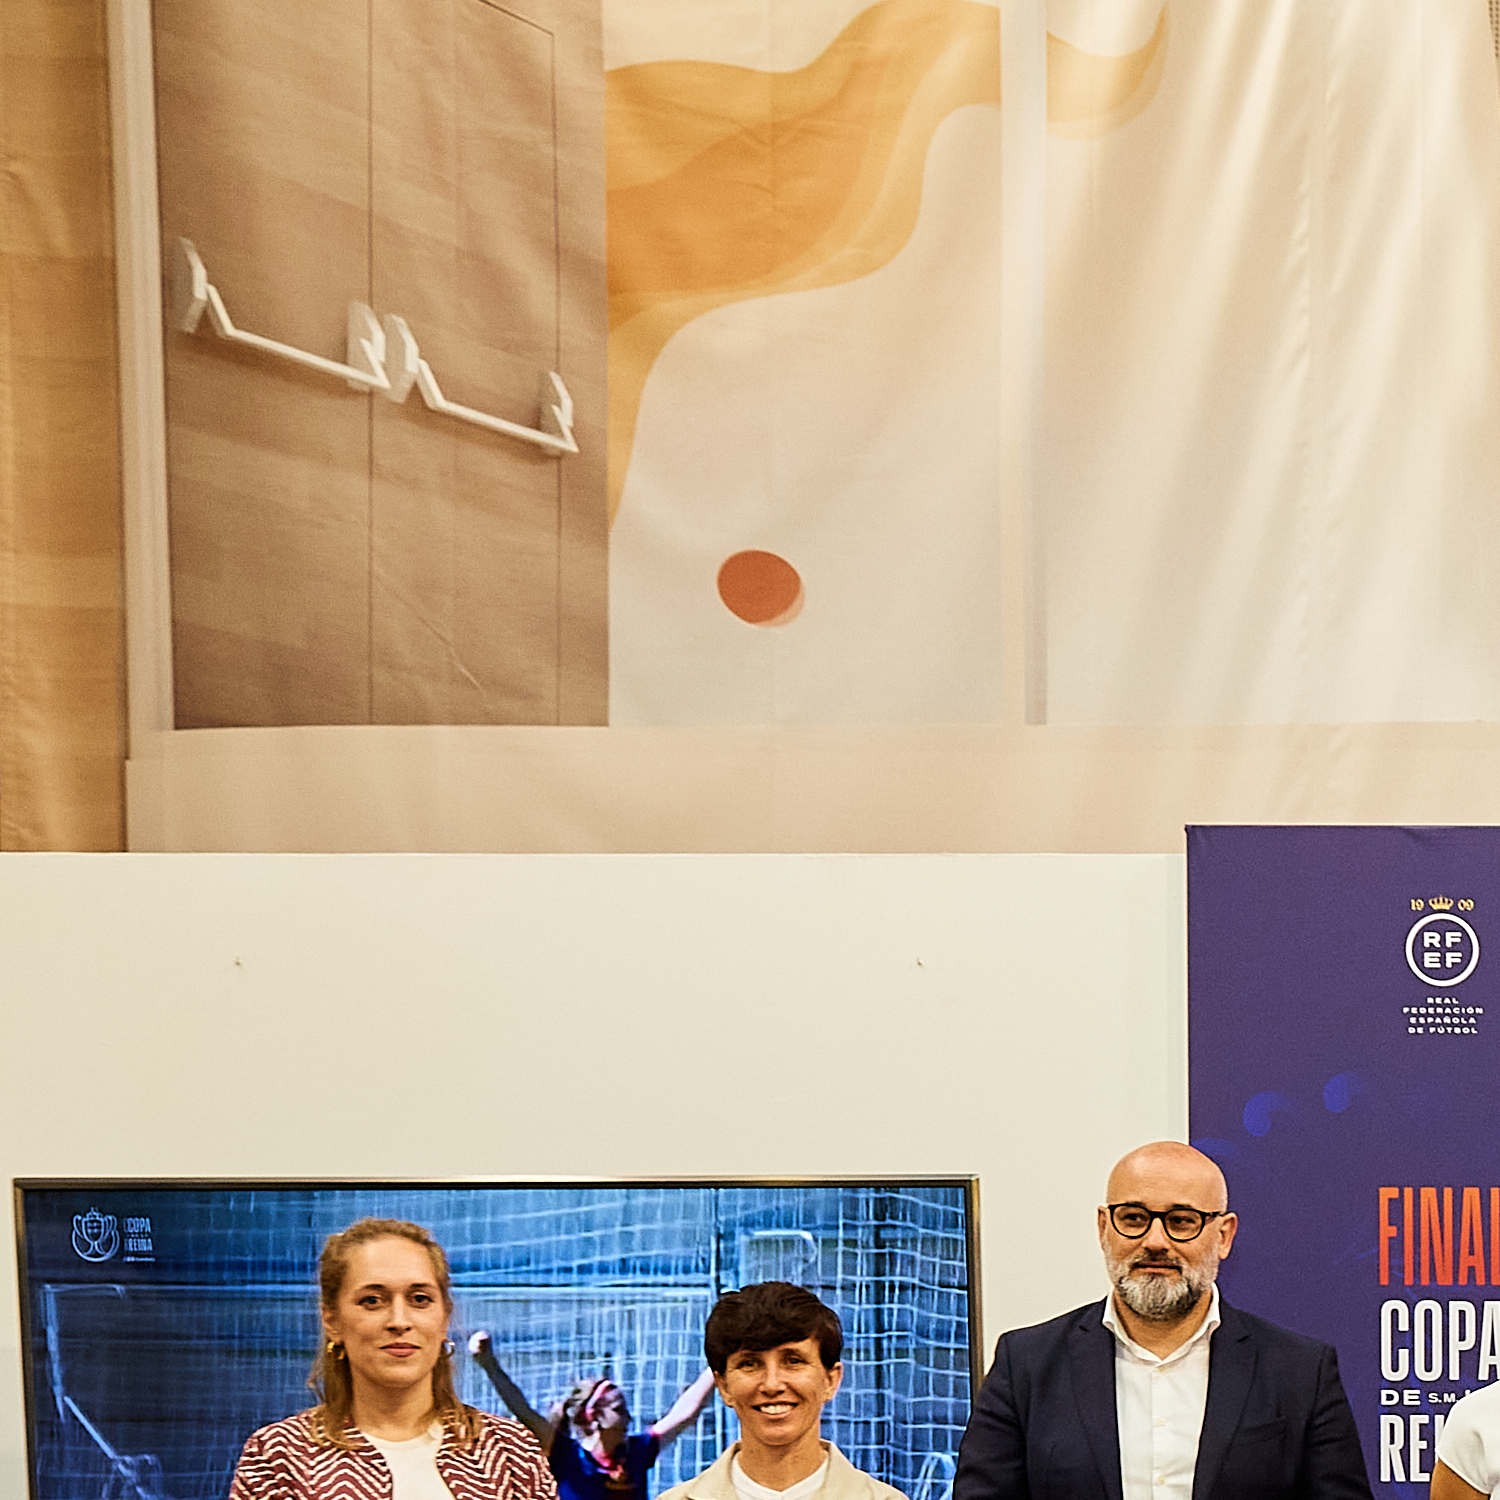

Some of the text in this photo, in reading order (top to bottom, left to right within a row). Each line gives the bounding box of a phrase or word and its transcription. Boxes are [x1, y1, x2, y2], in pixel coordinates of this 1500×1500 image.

[1410, 898, 1475, 911] 19 09
[1402, 1005, 1484, 1014] FEDERACIÓN
[1409, 1016, 1476, 1024] ESPAÑOLA
[1429, 1025, 1478, 1034] FÚTBOL
[1380, 1389, 1421, 1406] DE
